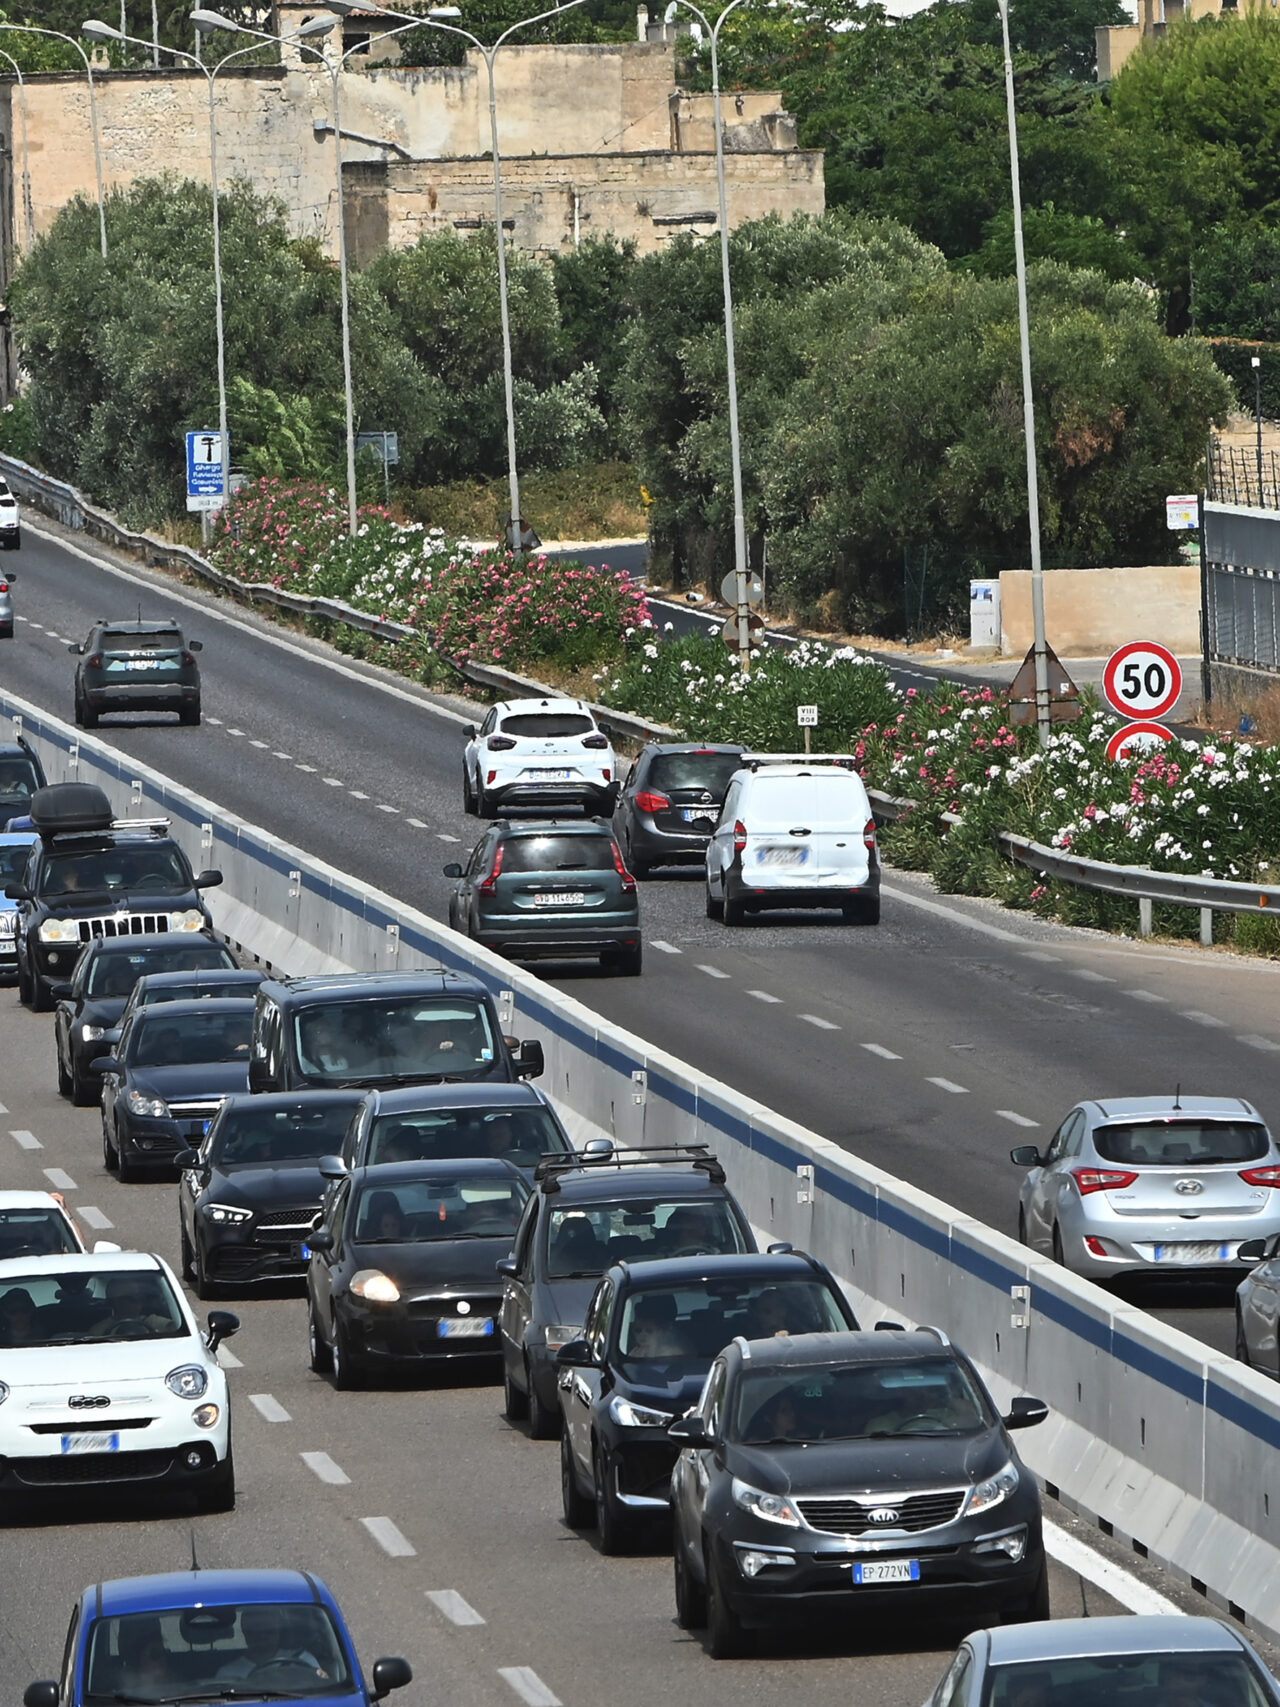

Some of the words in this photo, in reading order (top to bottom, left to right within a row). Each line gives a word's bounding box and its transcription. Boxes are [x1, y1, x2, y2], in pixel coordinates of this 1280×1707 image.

[1121, 663, 1166, 699] 50
[68, 1395, 111, 1410] 500
[871, 1510, 897, 1522] KIA
[863, 1566, 875, 1579] EP
[878, 1564, 910, 1579] 272VN
